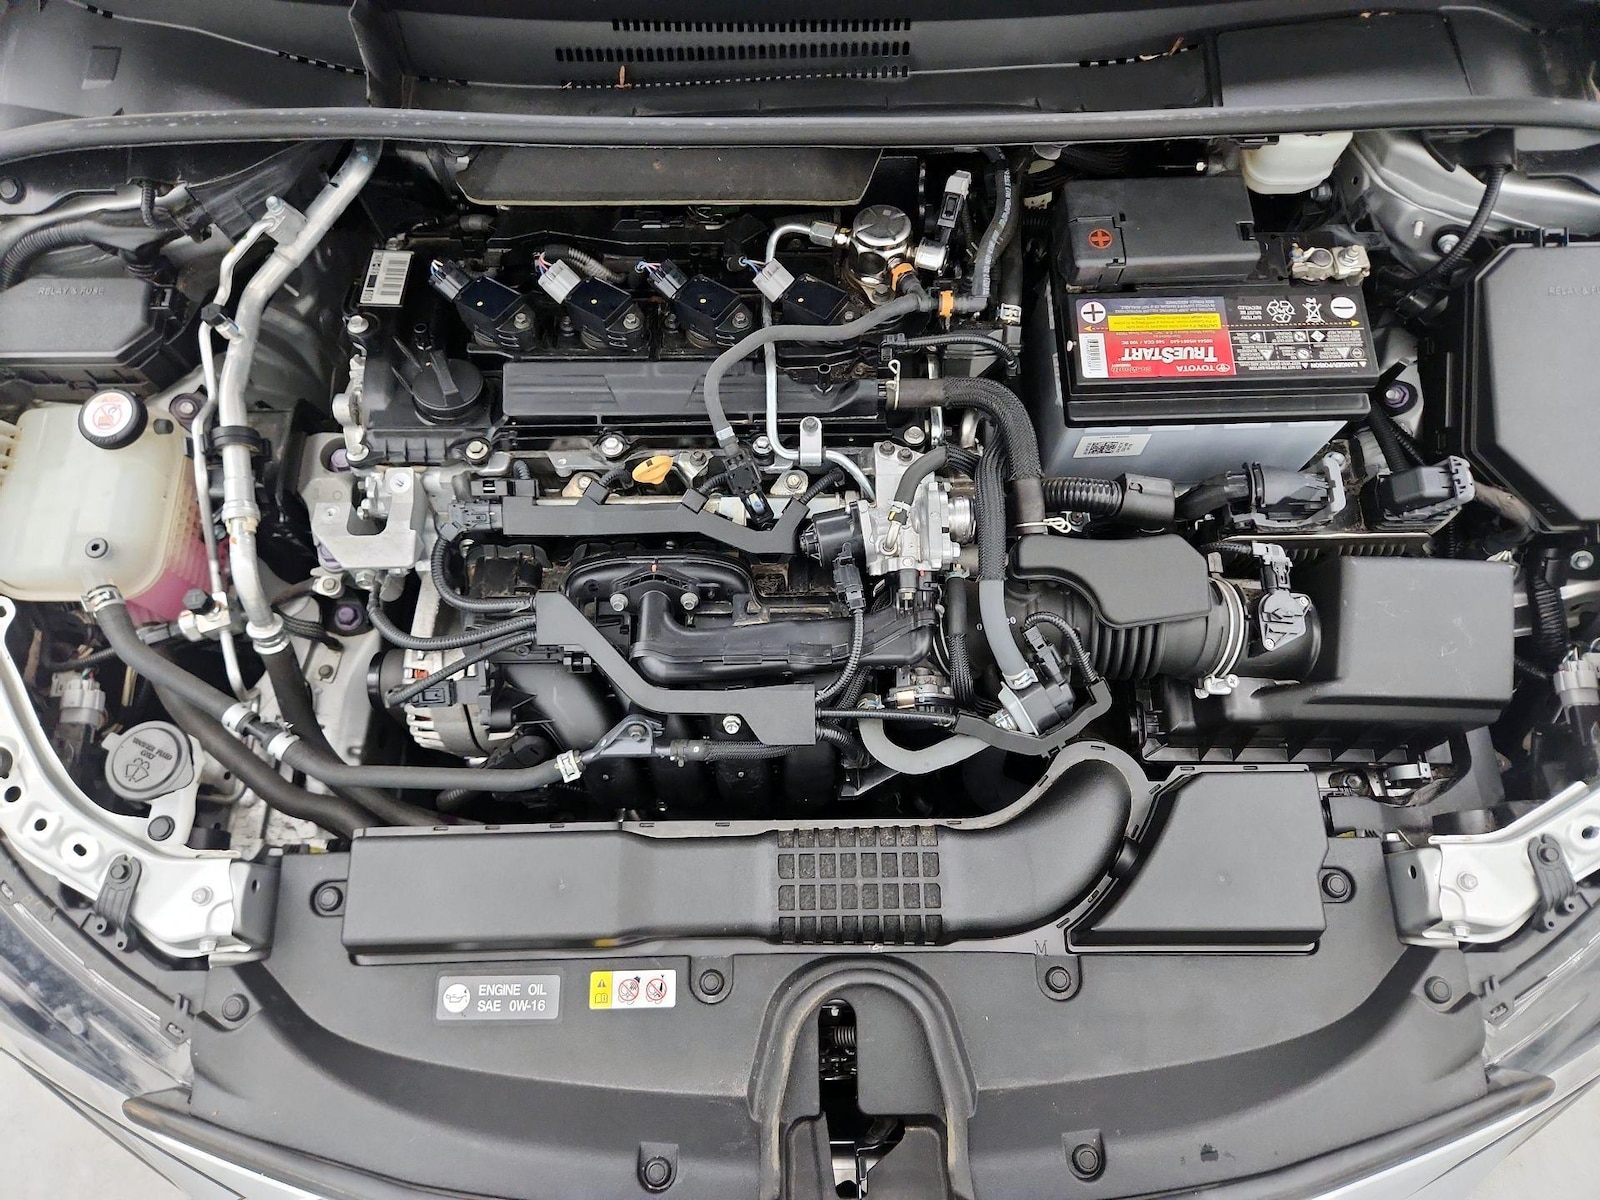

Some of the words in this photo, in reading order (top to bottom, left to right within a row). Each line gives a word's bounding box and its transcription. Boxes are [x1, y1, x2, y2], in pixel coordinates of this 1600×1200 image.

[38, 287, 69, 296] RELAY
[80, 287, 104, 296] FUSE
[1176, 364, 1215, 372] TOYOTA
[132, 737, 156, 752] WASHER
[155, 749, 173, 761] FLUID
[140, 749, 156, 760] ONLY
[478, 984, 521, 996] ENGINE
[528, 983, 547, 996] OIL
[477, 1000, 501, 1012] SAE
[509, 999, 546, 1011] 0W-16
